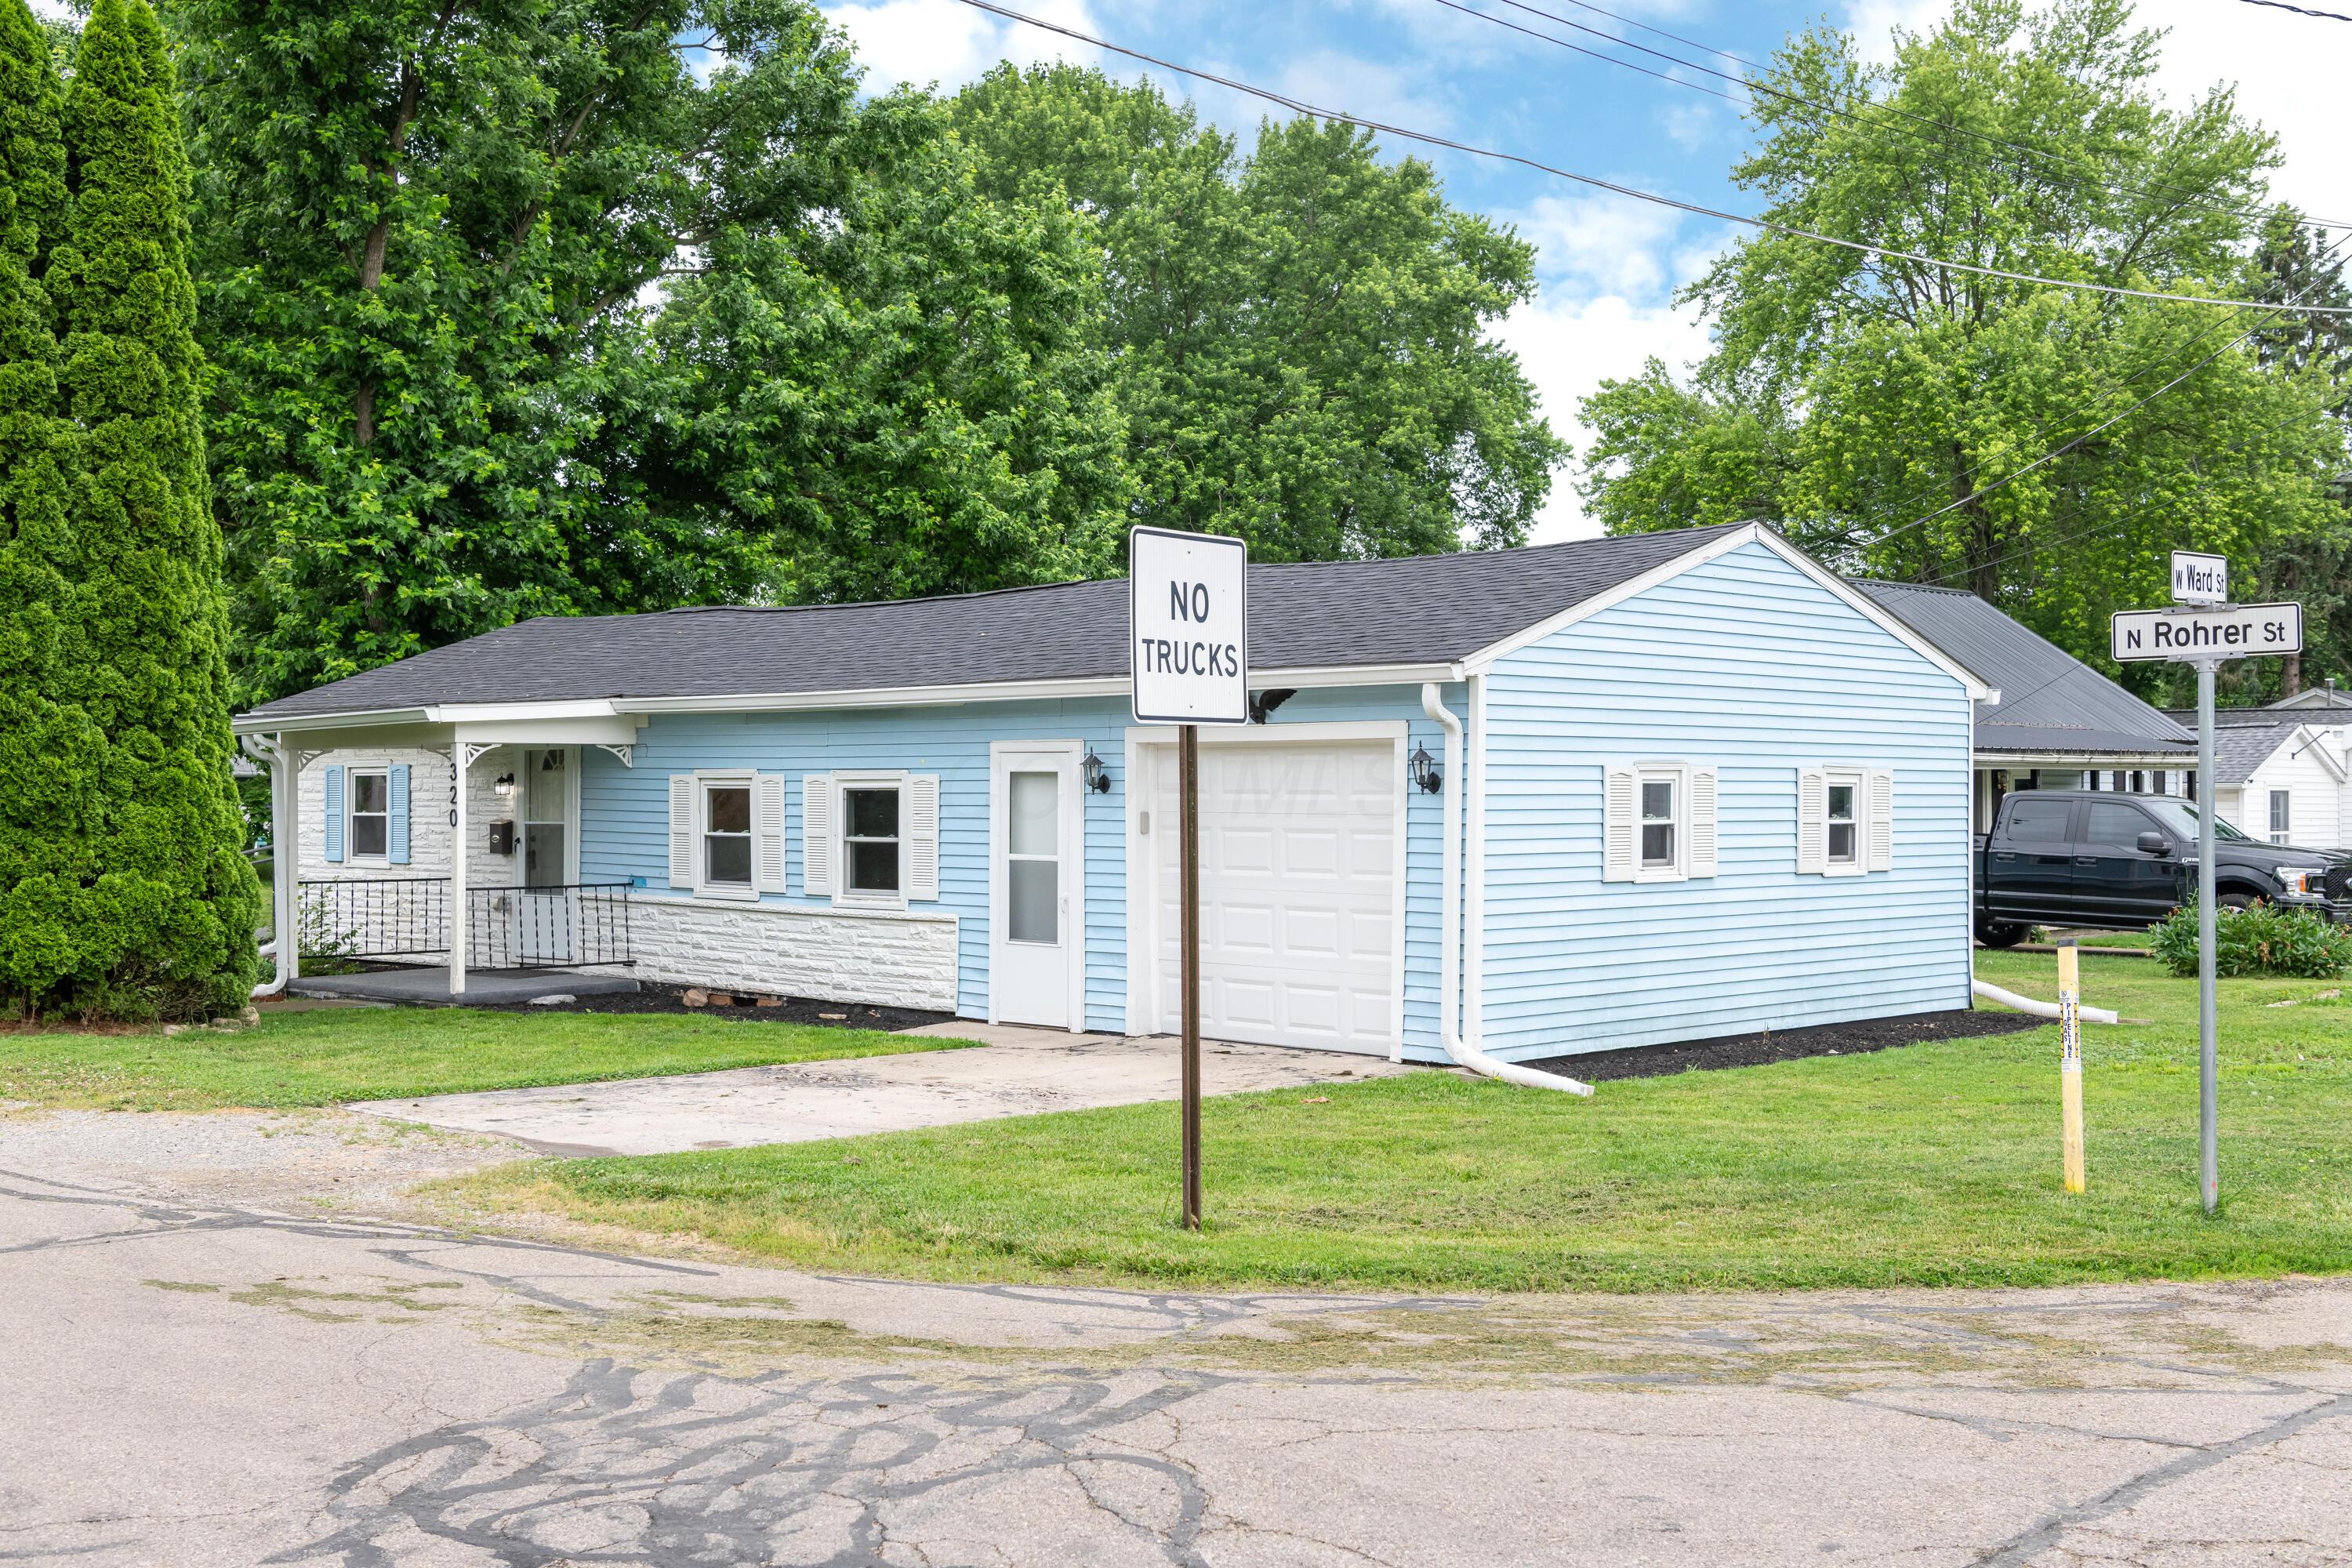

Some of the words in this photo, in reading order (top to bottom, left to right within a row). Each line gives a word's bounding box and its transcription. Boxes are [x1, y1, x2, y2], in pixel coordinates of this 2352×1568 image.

[2176, 568, 2183, 590] W
[2187, 564, 2212, 593] Ward
[2216, 572, 2224, 593] St
[1171, 580, 1209, 623] NO
[2127, 629, 2141, 649] N
[2154, 620, 2252, 648] Rohrer
[2263, 622, 2285, 642] St
[1142, 638, 1238, 678] TRUCKS
